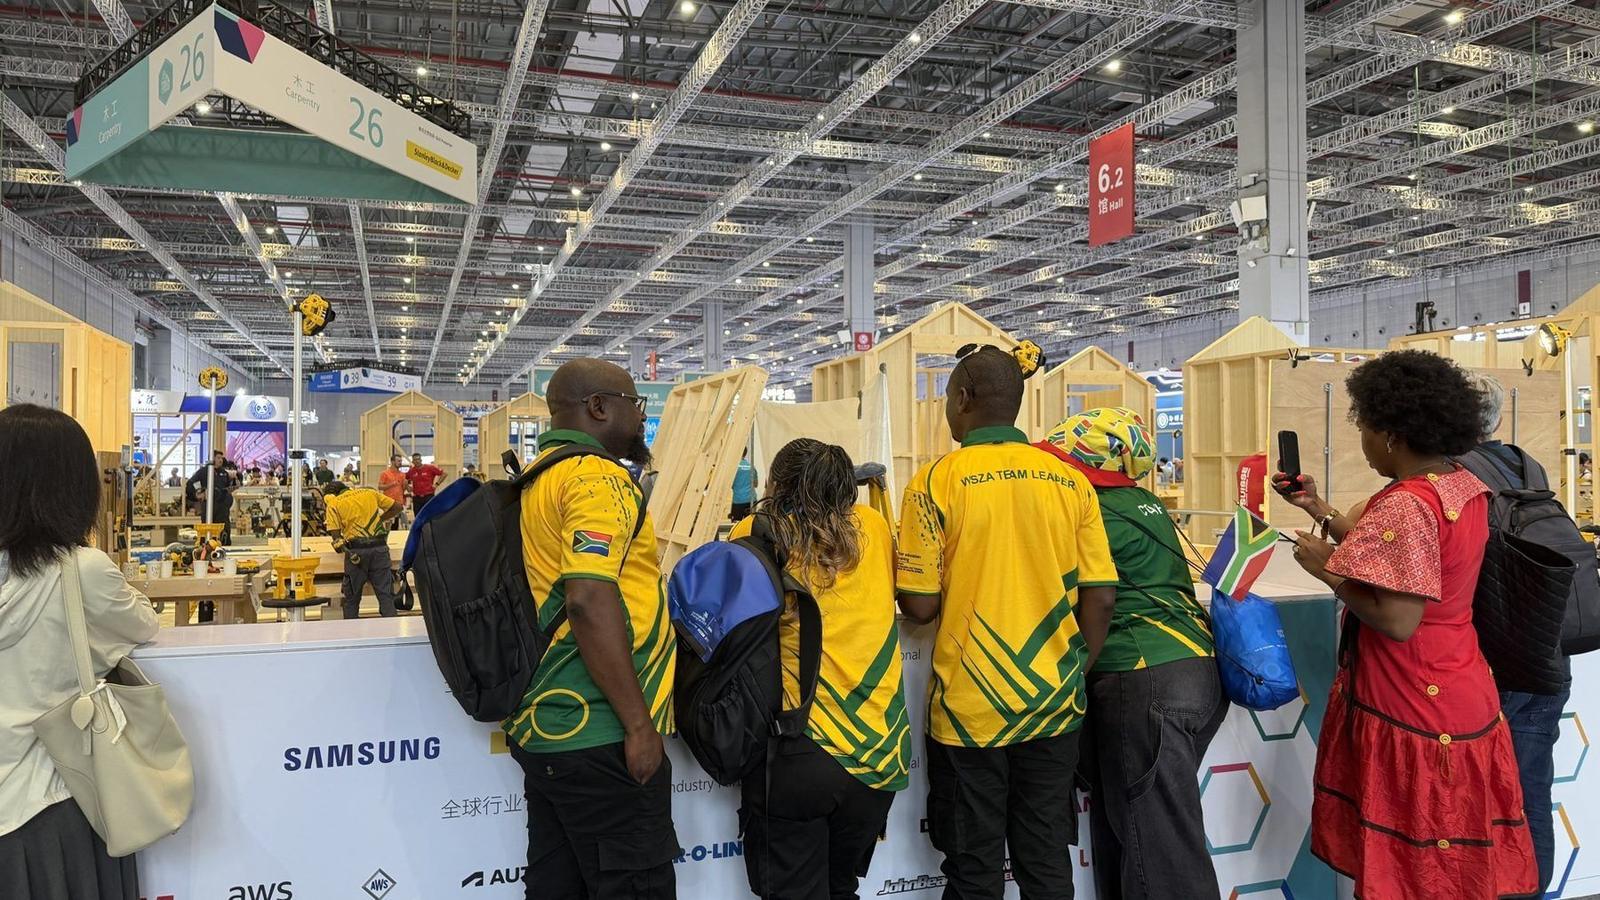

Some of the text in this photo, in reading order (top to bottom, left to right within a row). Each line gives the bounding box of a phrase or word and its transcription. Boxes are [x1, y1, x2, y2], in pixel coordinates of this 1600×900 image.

[180, 32, 205, 92] 26
[292, 73, 316, 95] 木工
[285, 87, 321, 112] Carpentry
[103, 100, 119, 122] 木工
[349, 96, 384, 148] 26
[98, 122, 122, 145] Carpentry
[1098, 164, 1124, 194] 6.2
[1098, 197, 1124, 216] 馆 Hall
[351, 372, 360, 384] 39
[387, 375, 397, 388] 39
[996, 469, 1028, 480] TEAM
[1031, 469, 1077, 490] LEADER
[283, 736, 441, 772] SAMSUNG
[672, 780, 714, 793] ndustry
[441, 793, 523, 819] 全球行业
[673, 841, 744, 864] R-O-LIN
[228, 881, 293, 900] aws
[370, 879, 389, 892] AWS
[877, 875, 947, 896] JohnBea
